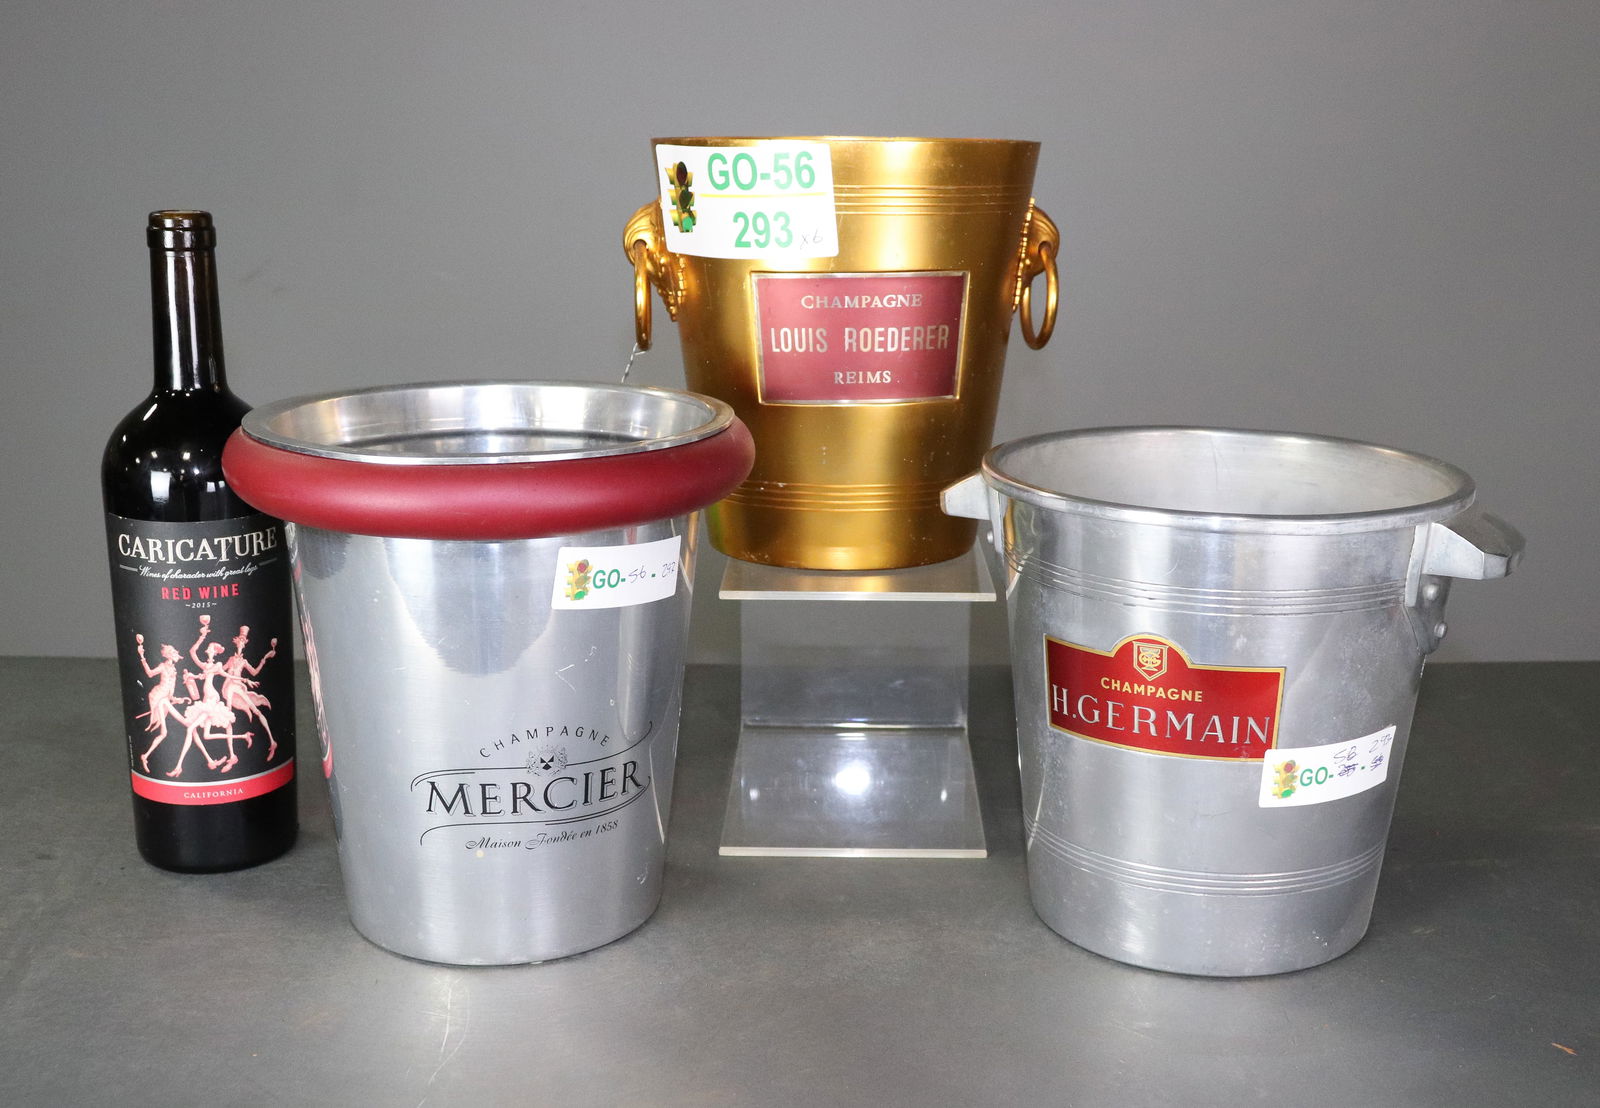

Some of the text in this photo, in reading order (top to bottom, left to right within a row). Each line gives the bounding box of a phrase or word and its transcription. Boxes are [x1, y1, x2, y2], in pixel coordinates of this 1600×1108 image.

[708, 151, 815, 191] GO-56
[733, 211, 793, 248] 293
[801, 294, 923, 309] CHAMPAGNE
[770, 324, 949, 353] LOUIS ROEDERER
[834, 370, 892, 385] REIMS
[118, 527, 278, 564] CARICATURE
[139, 562, 258, 581] Wines of character with great legs
[161, 583, 240, 600] RED WINE
[1100, 677, 1203, 702] CHAMPAGNE
[479, 726, 610, 758] CHAMPAGNE
[183, 788, 244, 799] CALIFORNIA
[426, 760, 646, 817] MERCIER
[465, 820, 619, 850] Maison Fondée en 1858
